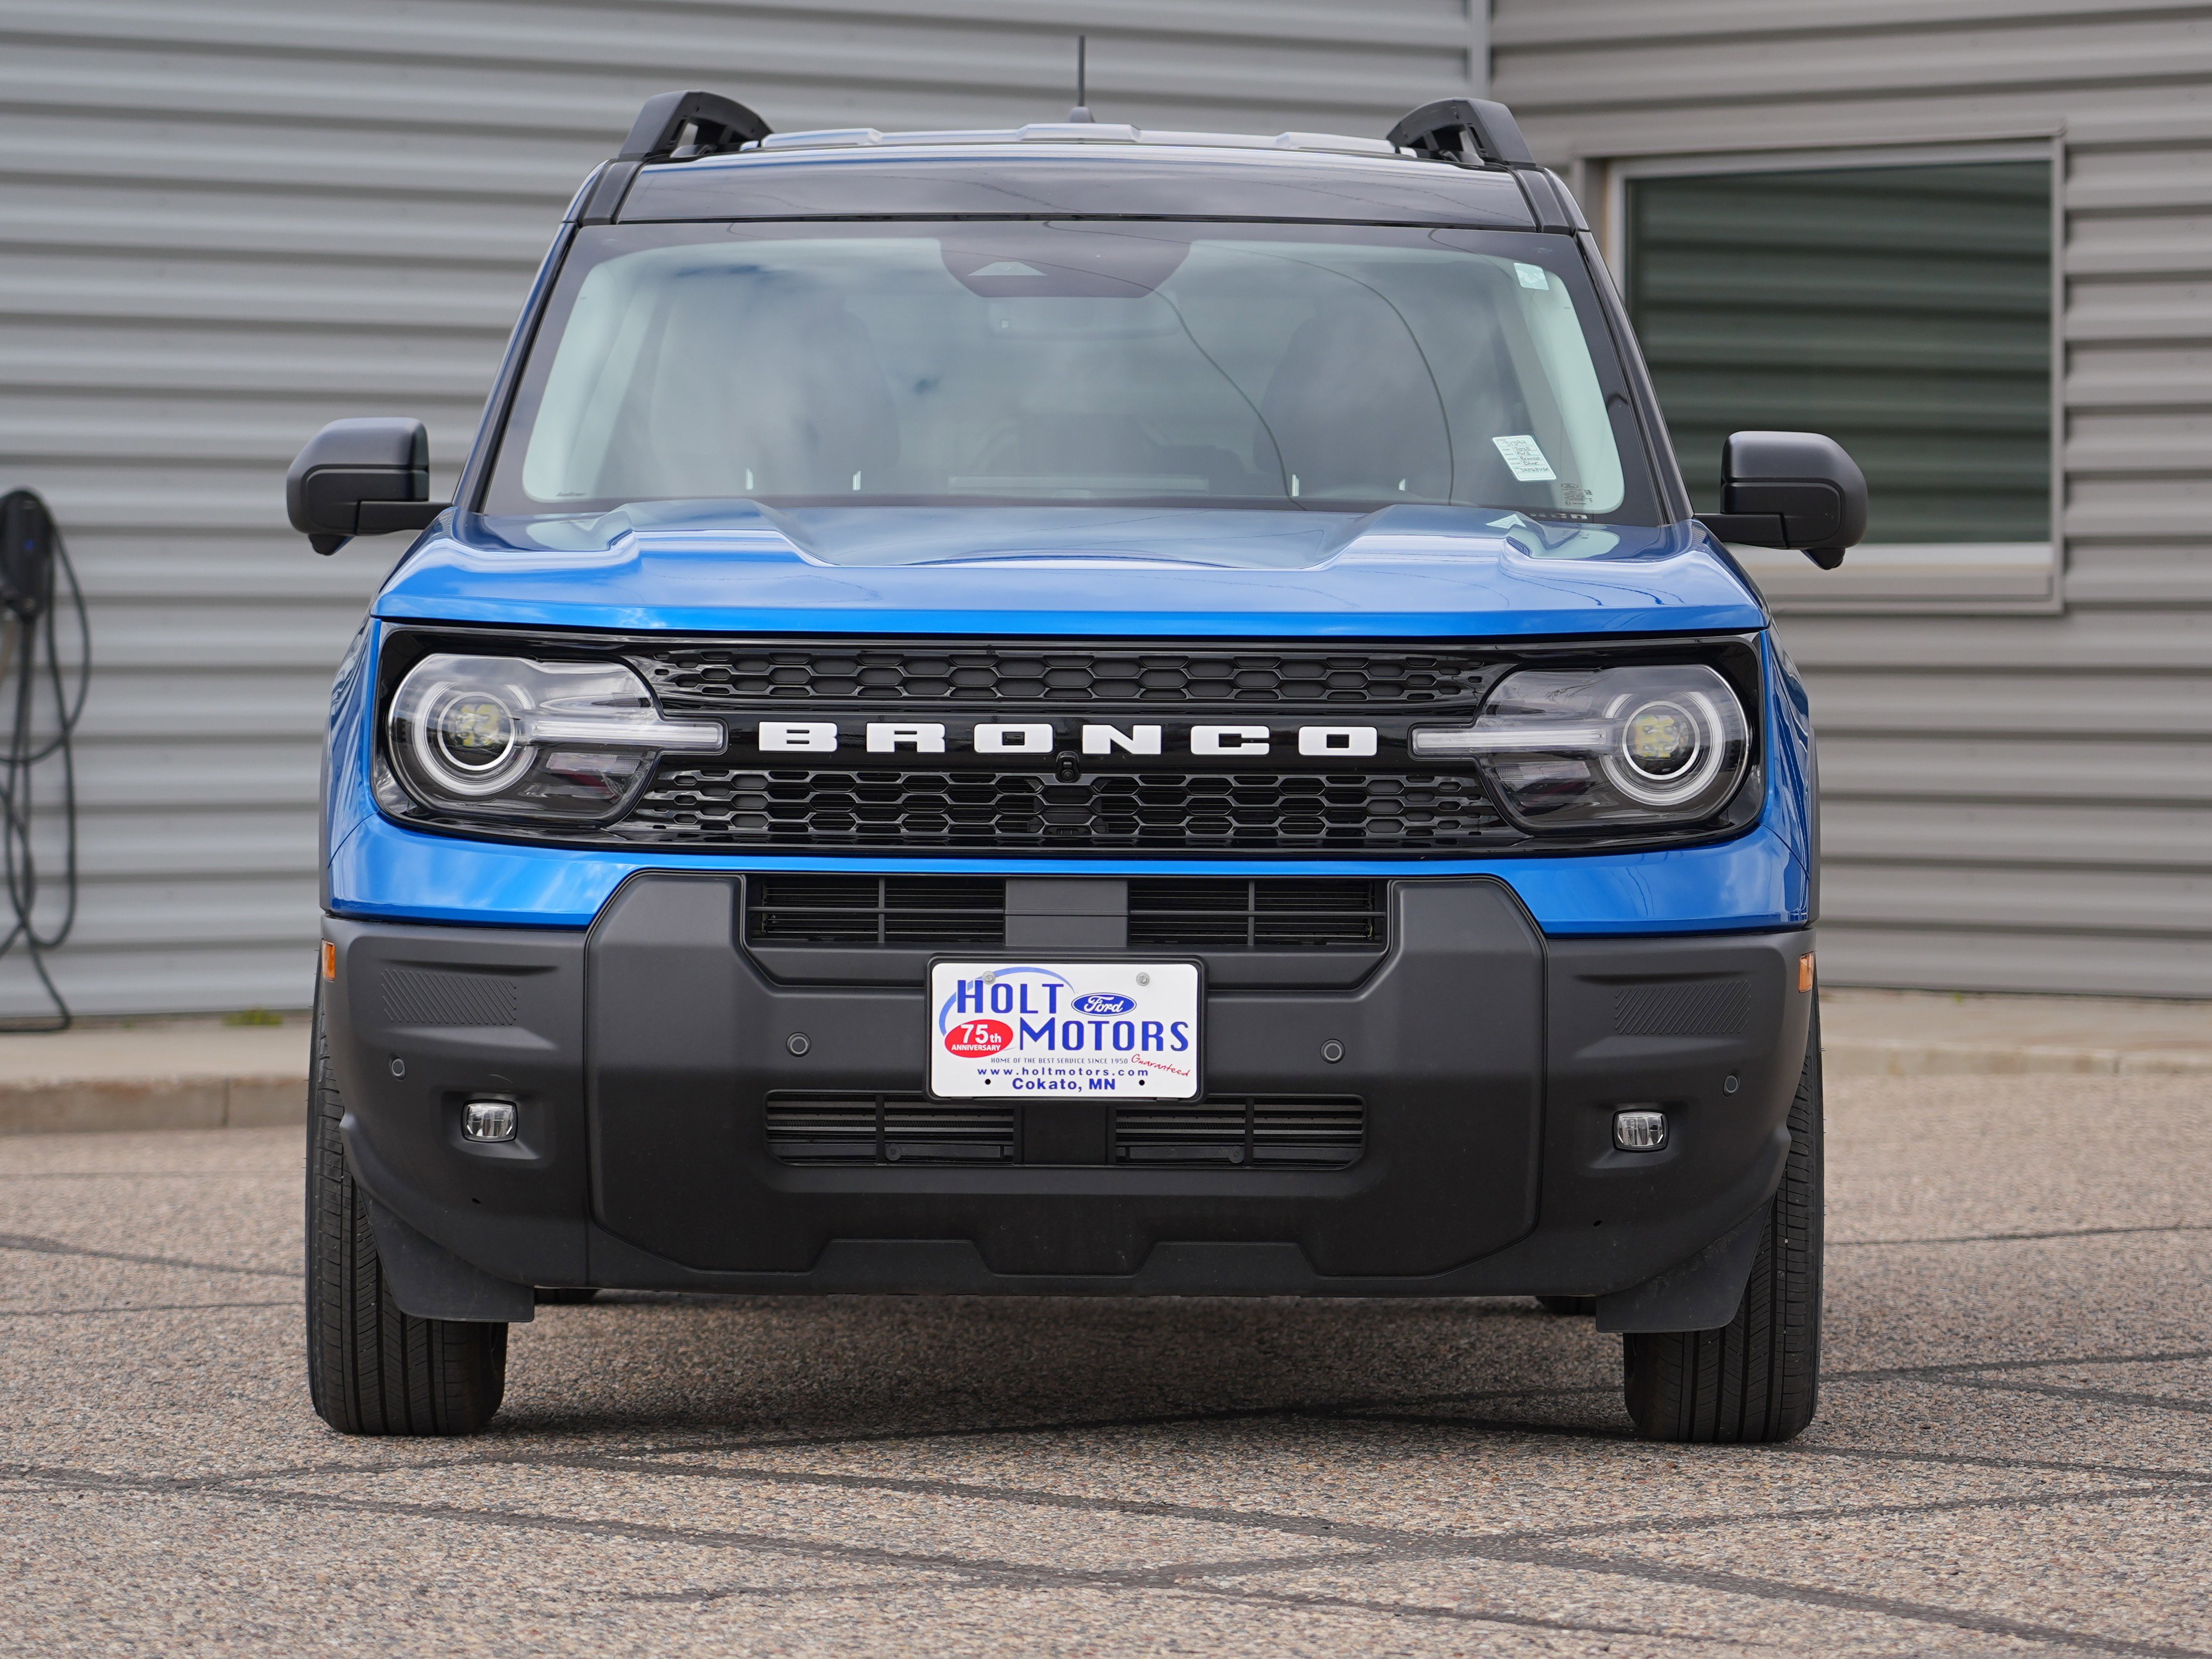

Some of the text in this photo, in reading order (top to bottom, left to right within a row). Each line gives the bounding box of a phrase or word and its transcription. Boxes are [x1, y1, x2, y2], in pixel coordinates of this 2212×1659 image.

[758, 721, 1378, 757] BRONCO
[957, 980, 1063, 1014] HOLT
[1083, 995, 1124, 1013] Ford
[961, 1024, 1002, 1044] 75th
[1020, 1017, 1189, 1051] MOTORS
[977, 1067, 1148, 1076] www.holtmotors.com
[1131, 1054, 1190, 1077] Guaranteed
[1012, 1078, 1116, 1092] Cokato, MN
